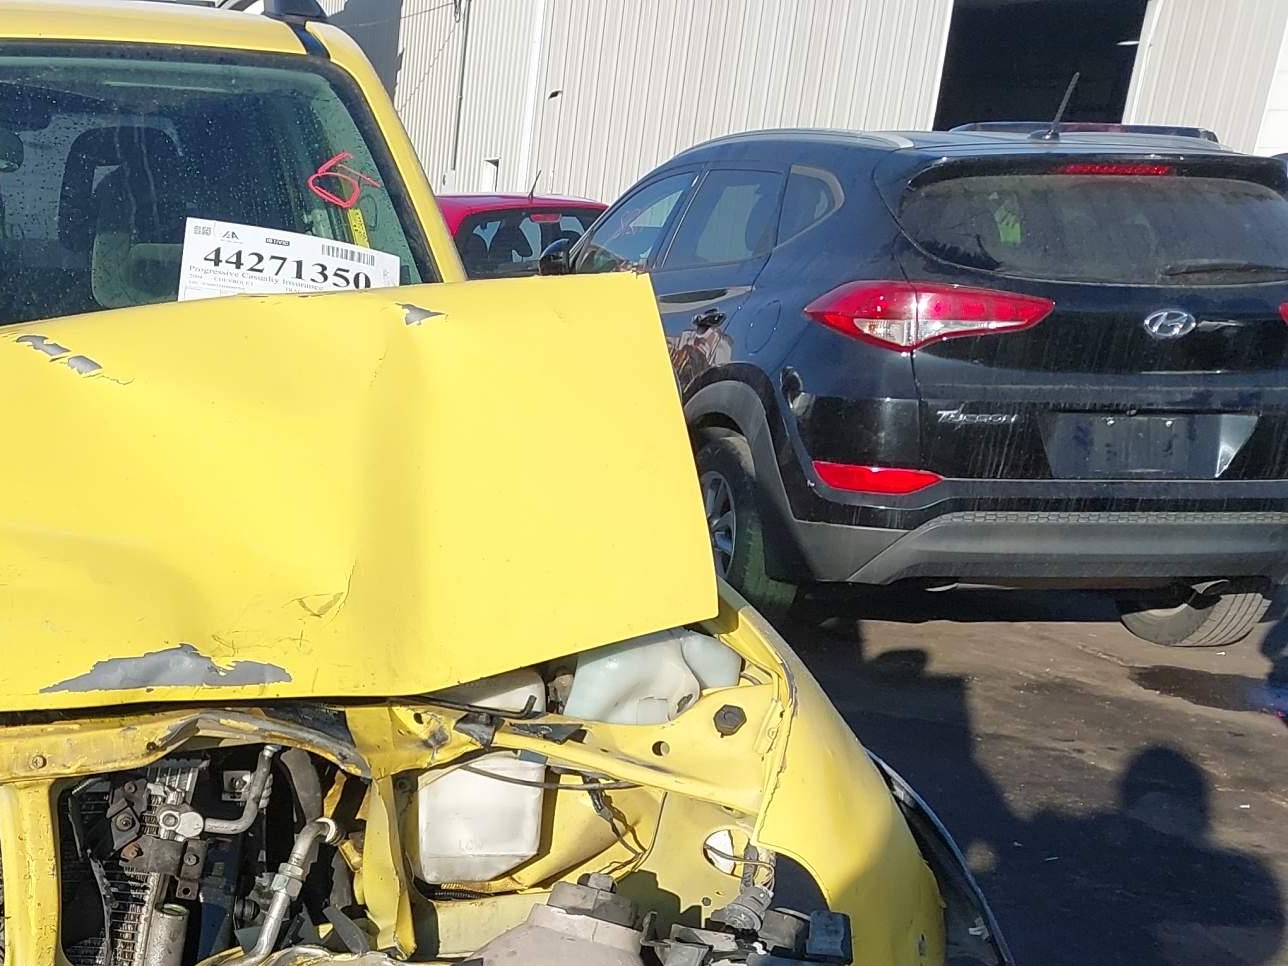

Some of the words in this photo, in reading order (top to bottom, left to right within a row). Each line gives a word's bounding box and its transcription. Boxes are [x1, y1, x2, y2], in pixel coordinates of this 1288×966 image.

[189, 264, 239, 278] Progressive
[242, 272, 278, 285] Casualty
[282, 279, 324, 291] Insurance
[203, 246, 371, 290] 44271350
